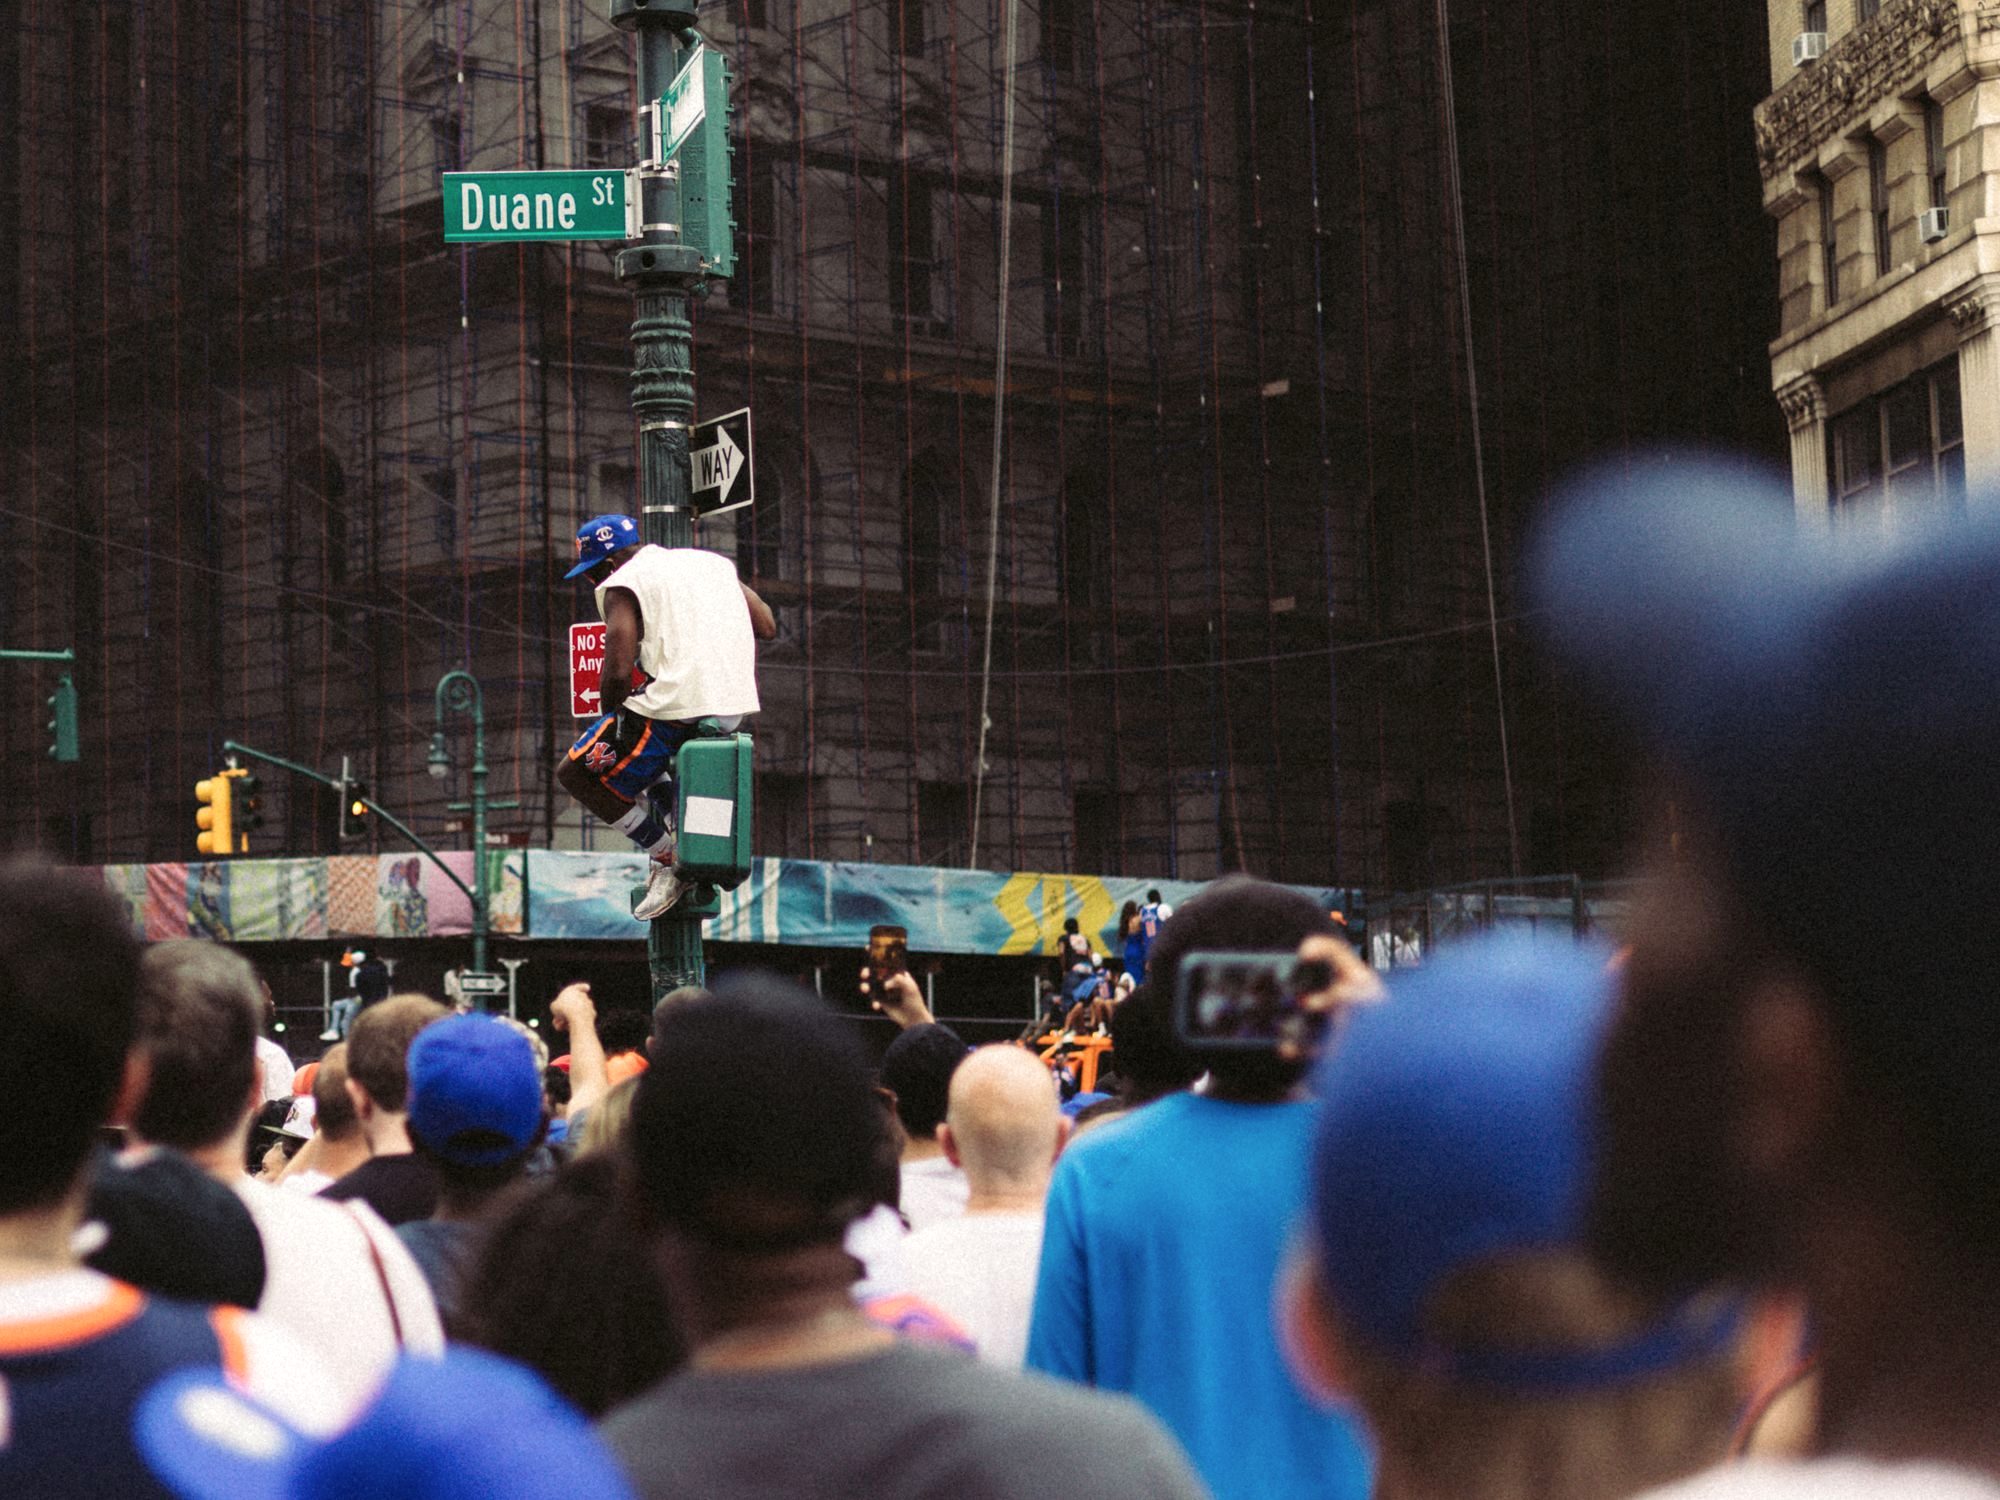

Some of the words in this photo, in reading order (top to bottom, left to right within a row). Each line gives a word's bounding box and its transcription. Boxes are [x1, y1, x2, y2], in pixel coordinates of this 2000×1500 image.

[461, 182, 577, 231] Duane
[592, 176, 615, 206] St
[701, 445, 733, 486] WAY
[577, 634, 596, 651] NO
[578, 655, 605, 674] Any
